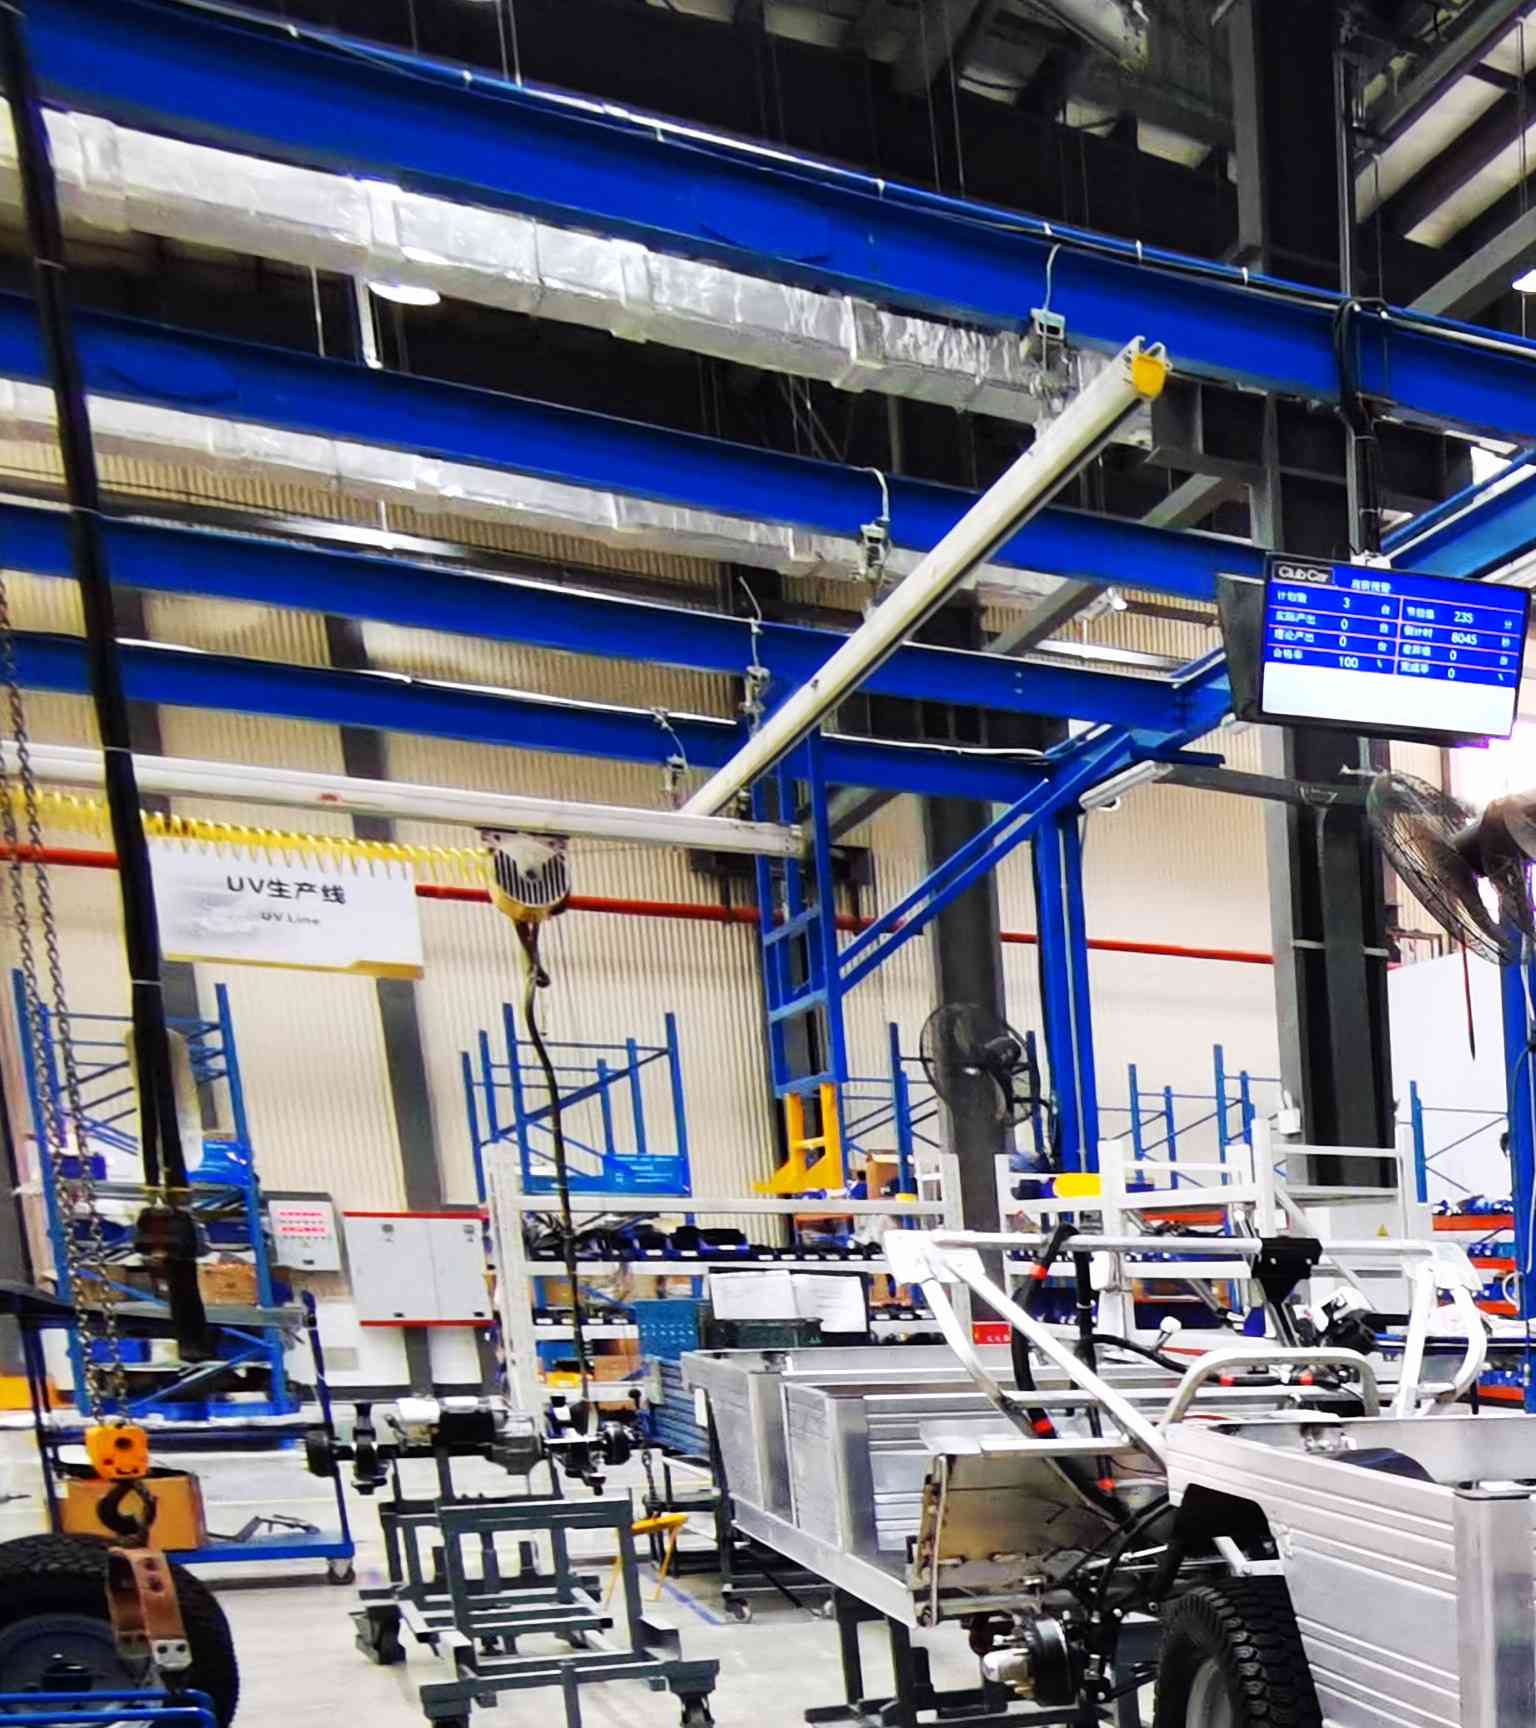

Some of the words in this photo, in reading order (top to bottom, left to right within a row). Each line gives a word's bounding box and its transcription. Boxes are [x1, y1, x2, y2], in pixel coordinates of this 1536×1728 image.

[1342, 597, 1351, 609] 3
[1340, 618, 1349, 630] 0
[1339, 635, 1348, 648] 0
[1449, 650, 1457, 661] 0
[1339, 656, 1359, 669] 100
[1447, 667, 1456, 680] 0
[227, 875, 346, 905] UV生产线
